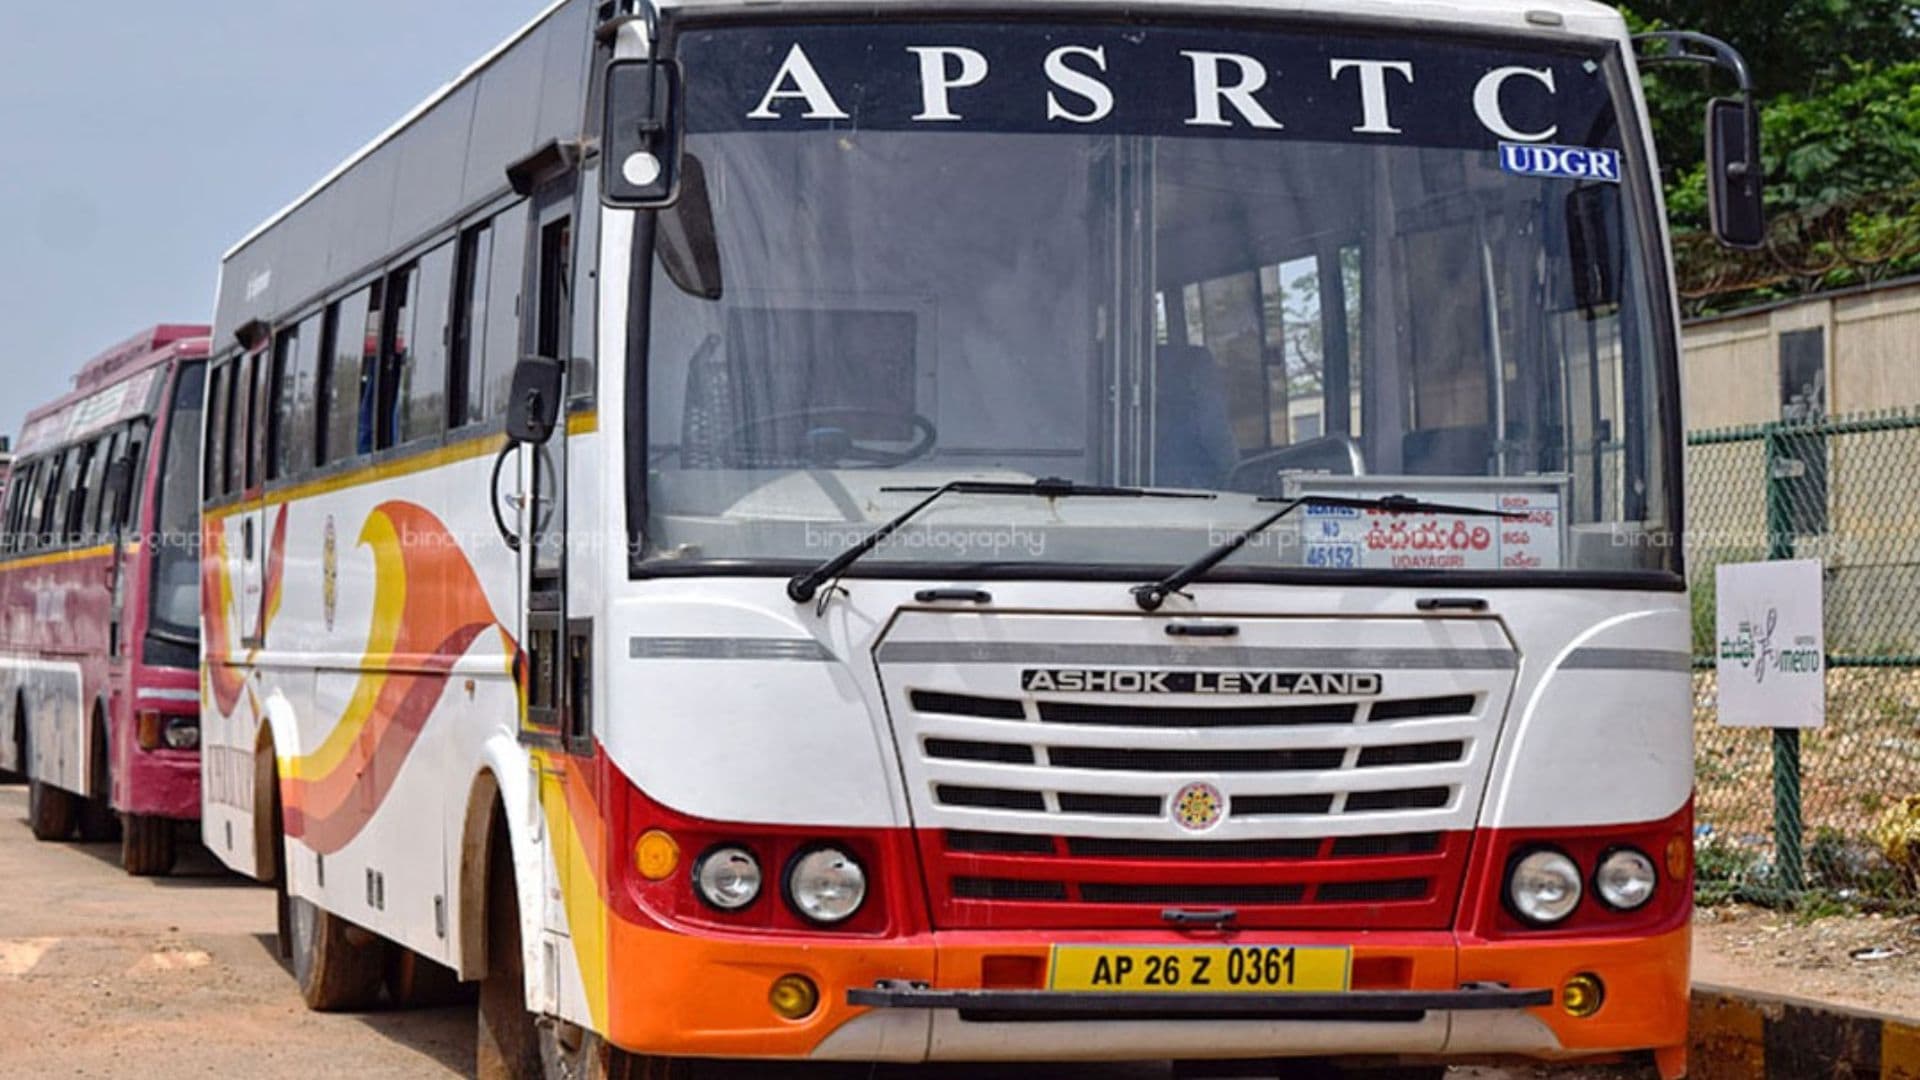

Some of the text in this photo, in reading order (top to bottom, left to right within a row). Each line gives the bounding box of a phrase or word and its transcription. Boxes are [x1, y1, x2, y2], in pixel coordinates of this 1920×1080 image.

[1505, 145, 1616, 178] UDGR
[1391, 555, 1464, 568] UDAYAGIRI
[1779, 649, 1820, 673] metro
[1027, 669, 1378, 695] ASHOK LEYLAND
[1091, 947, 1296, 985] AP 26 Z 0361
